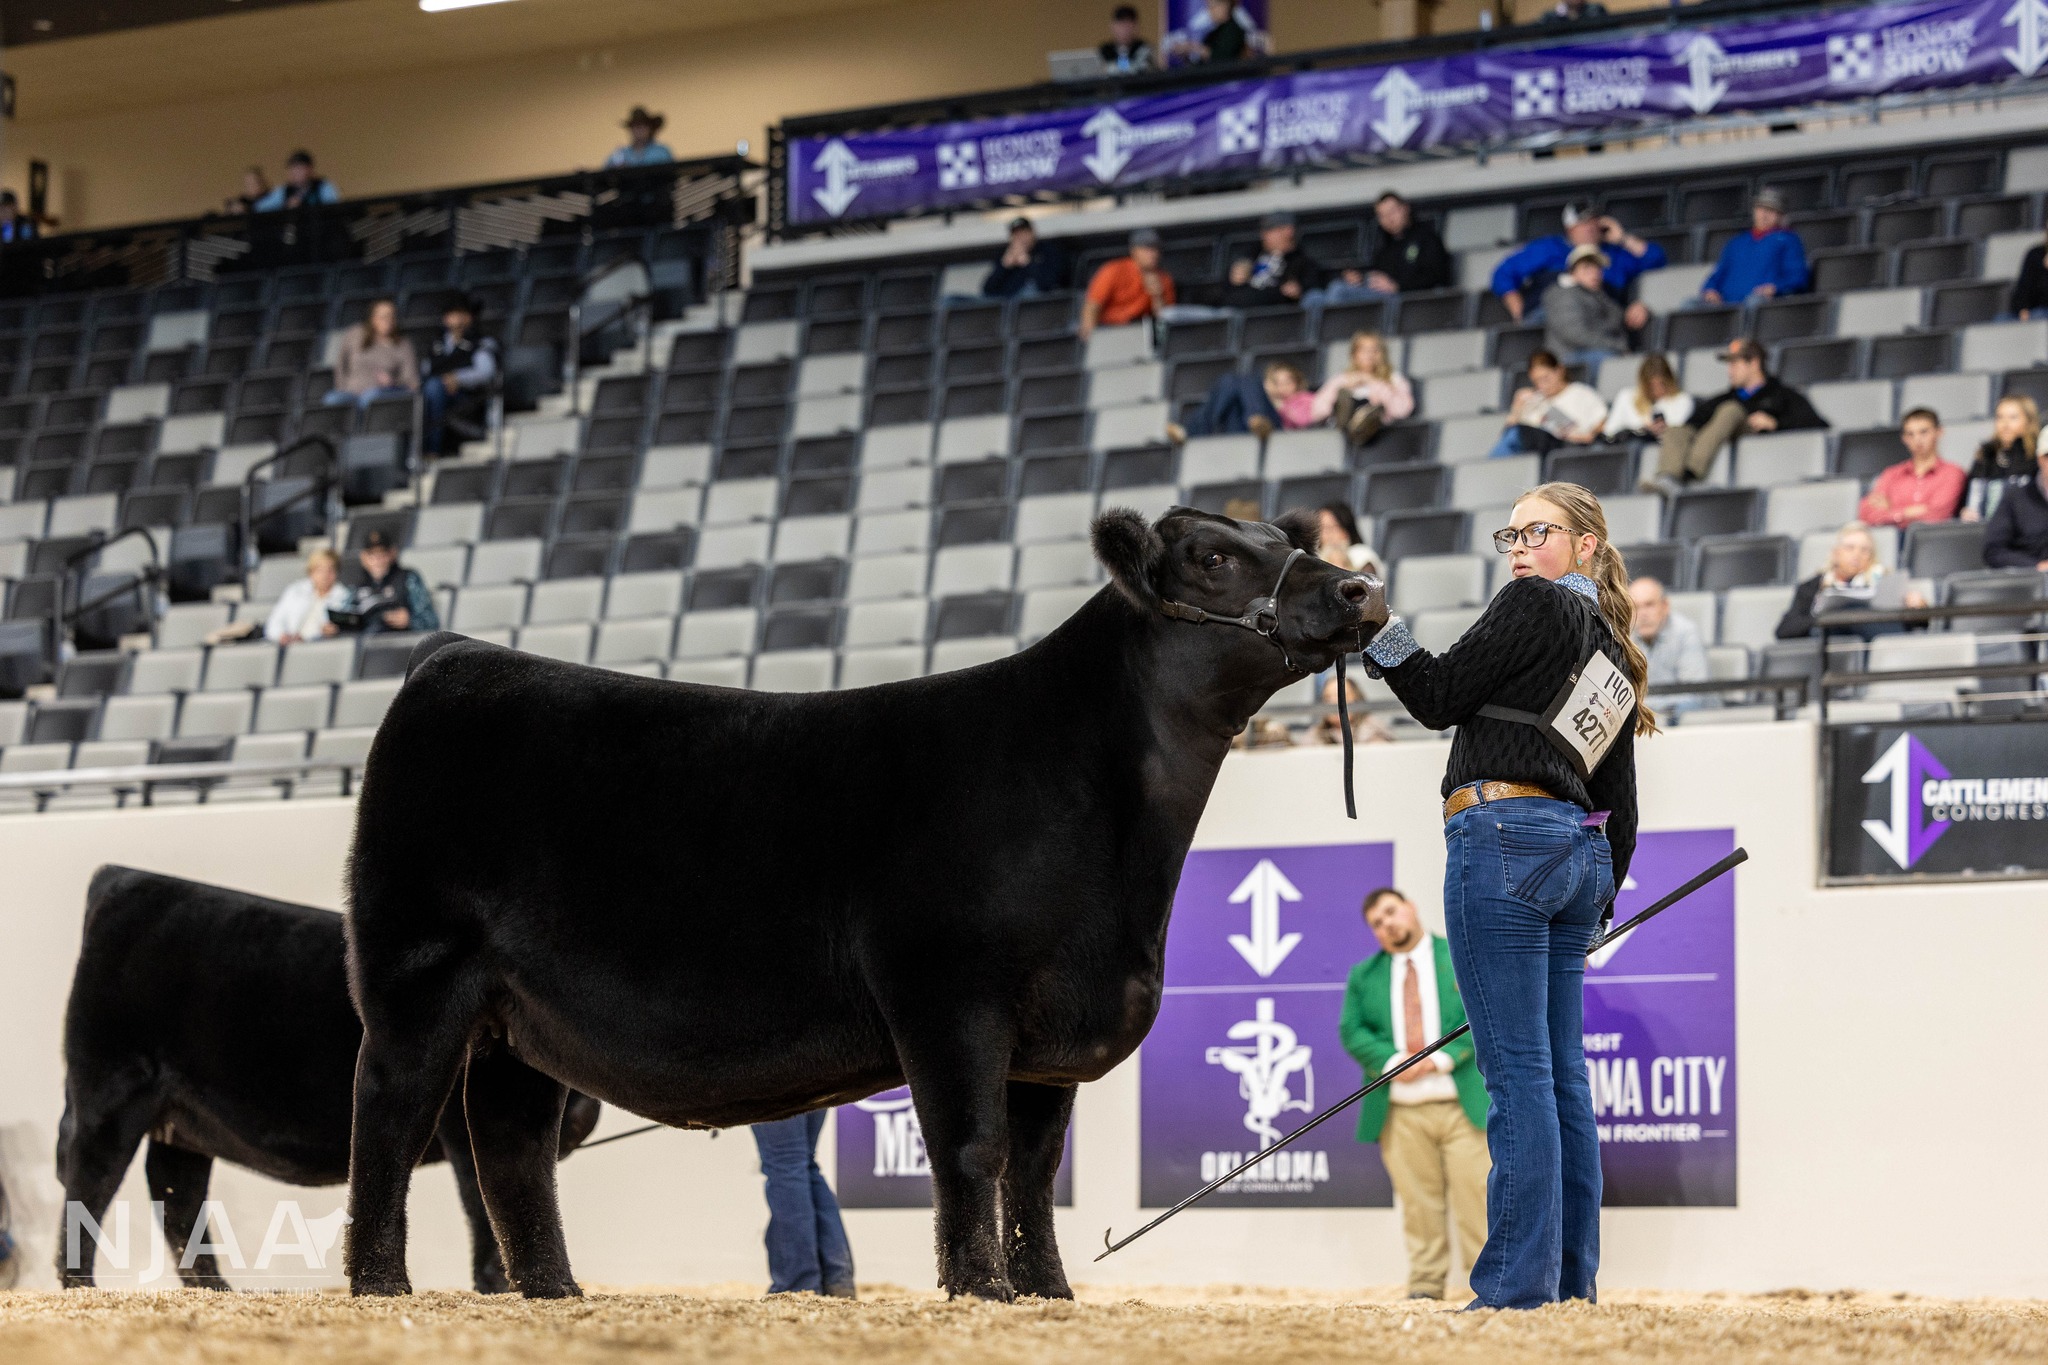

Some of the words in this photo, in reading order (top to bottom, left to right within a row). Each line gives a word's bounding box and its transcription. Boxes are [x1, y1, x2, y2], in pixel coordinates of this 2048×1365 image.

[1604, 671, 1633, 710] 1407
[1572, 707, 1608, 753] 4277
[1932, 802, 2048, 822] CONGRES
[1584, 1033, 1623, 1052] ISIT
[1651, 1056, 1727, 1117] CITY
[1613, 1123, 1701, 1143] FRONTIER
[1200, 1150, 1330, 1182] OKLAHOMA
